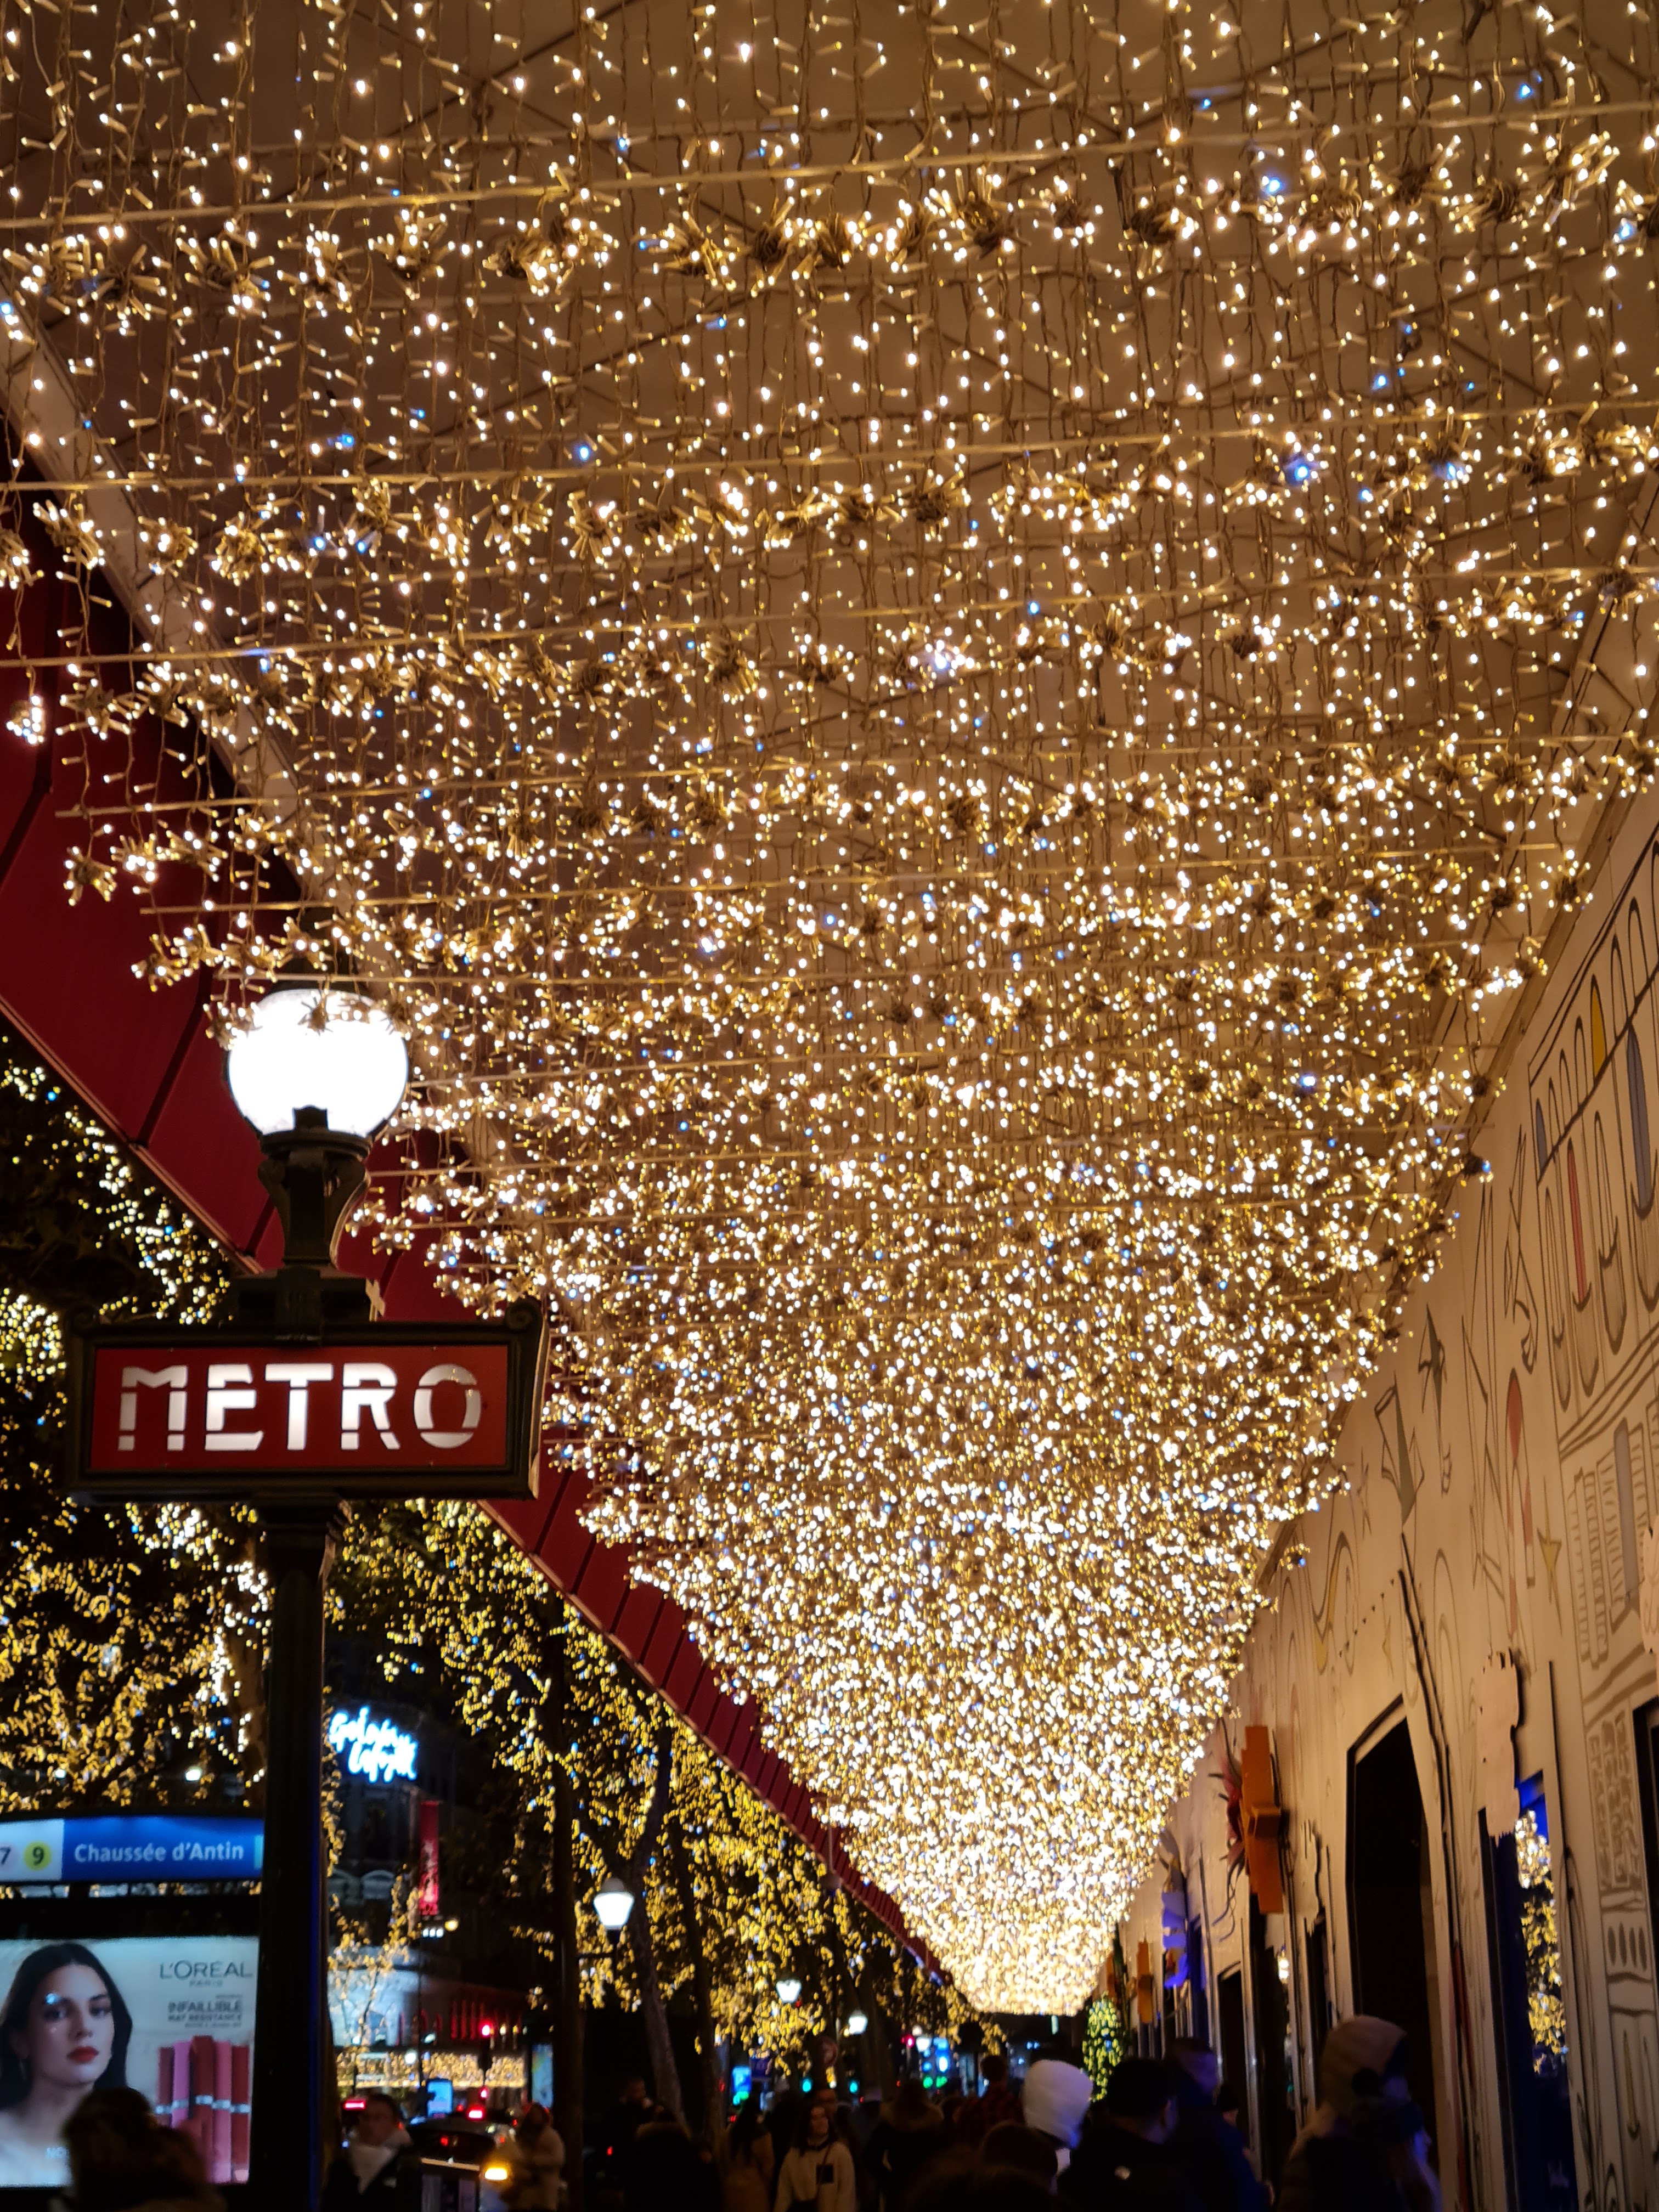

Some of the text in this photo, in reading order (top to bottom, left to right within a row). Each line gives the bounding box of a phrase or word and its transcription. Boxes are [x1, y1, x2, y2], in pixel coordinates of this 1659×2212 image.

[117, 1362, 482, 1451] METRO
[0, 1847, 44, 1865] 7 9
[75, 1841, 245, 1863] Chaussée d'Antin
